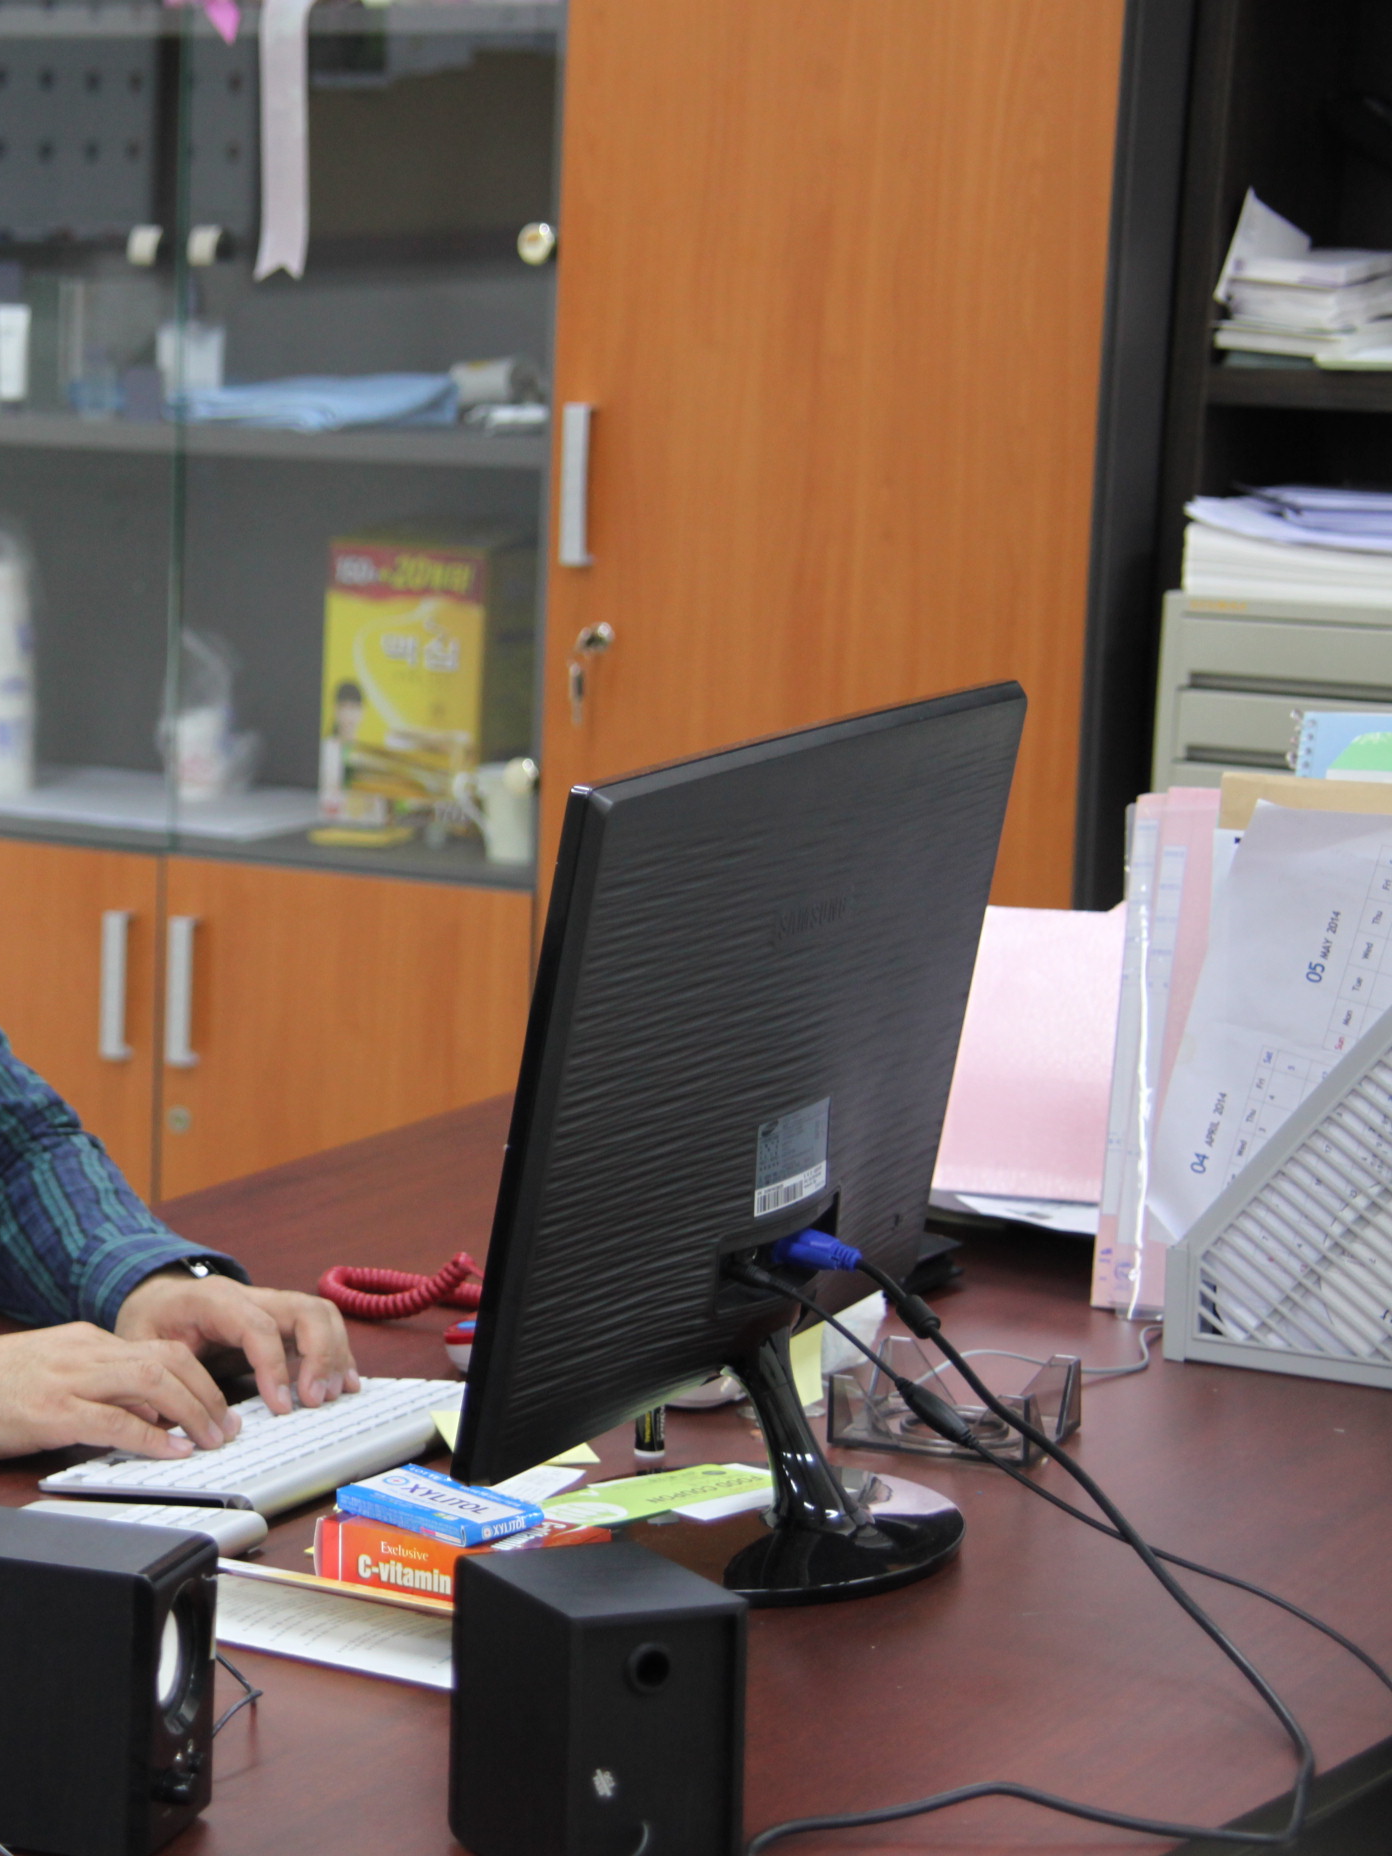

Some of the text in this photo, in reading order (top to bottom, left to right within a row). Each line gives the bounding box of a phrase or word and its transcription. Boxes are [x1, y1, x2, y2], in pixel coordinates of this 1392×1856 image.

[778, 896, 847, 936] SAMSUNG
[1306, 910, 1341, 983] 05 MAY 2014
[1334, 879, 1392, 1050] Sun Mon Tue Wed Thu Fri
[1245, 1109, 1256, 1123] Thu
[1263, 1051, 1273, 1064] Sat
[1190, 1092, 1227, 1174] 04 APRIL 2014
[409, 1467, 442, 1480] LOTTE
[717, 1475, 764, 1490] FOOD
[401, 1484, 489, 1514] XYLITOL
[646, 1484, 716, 1504] COUPON
[492, 1518, 527, 1537] XYLITOL
[381, 1541, 429, 1561] Exclusive
[358, 1554, 452, 1595] C-vitamin
